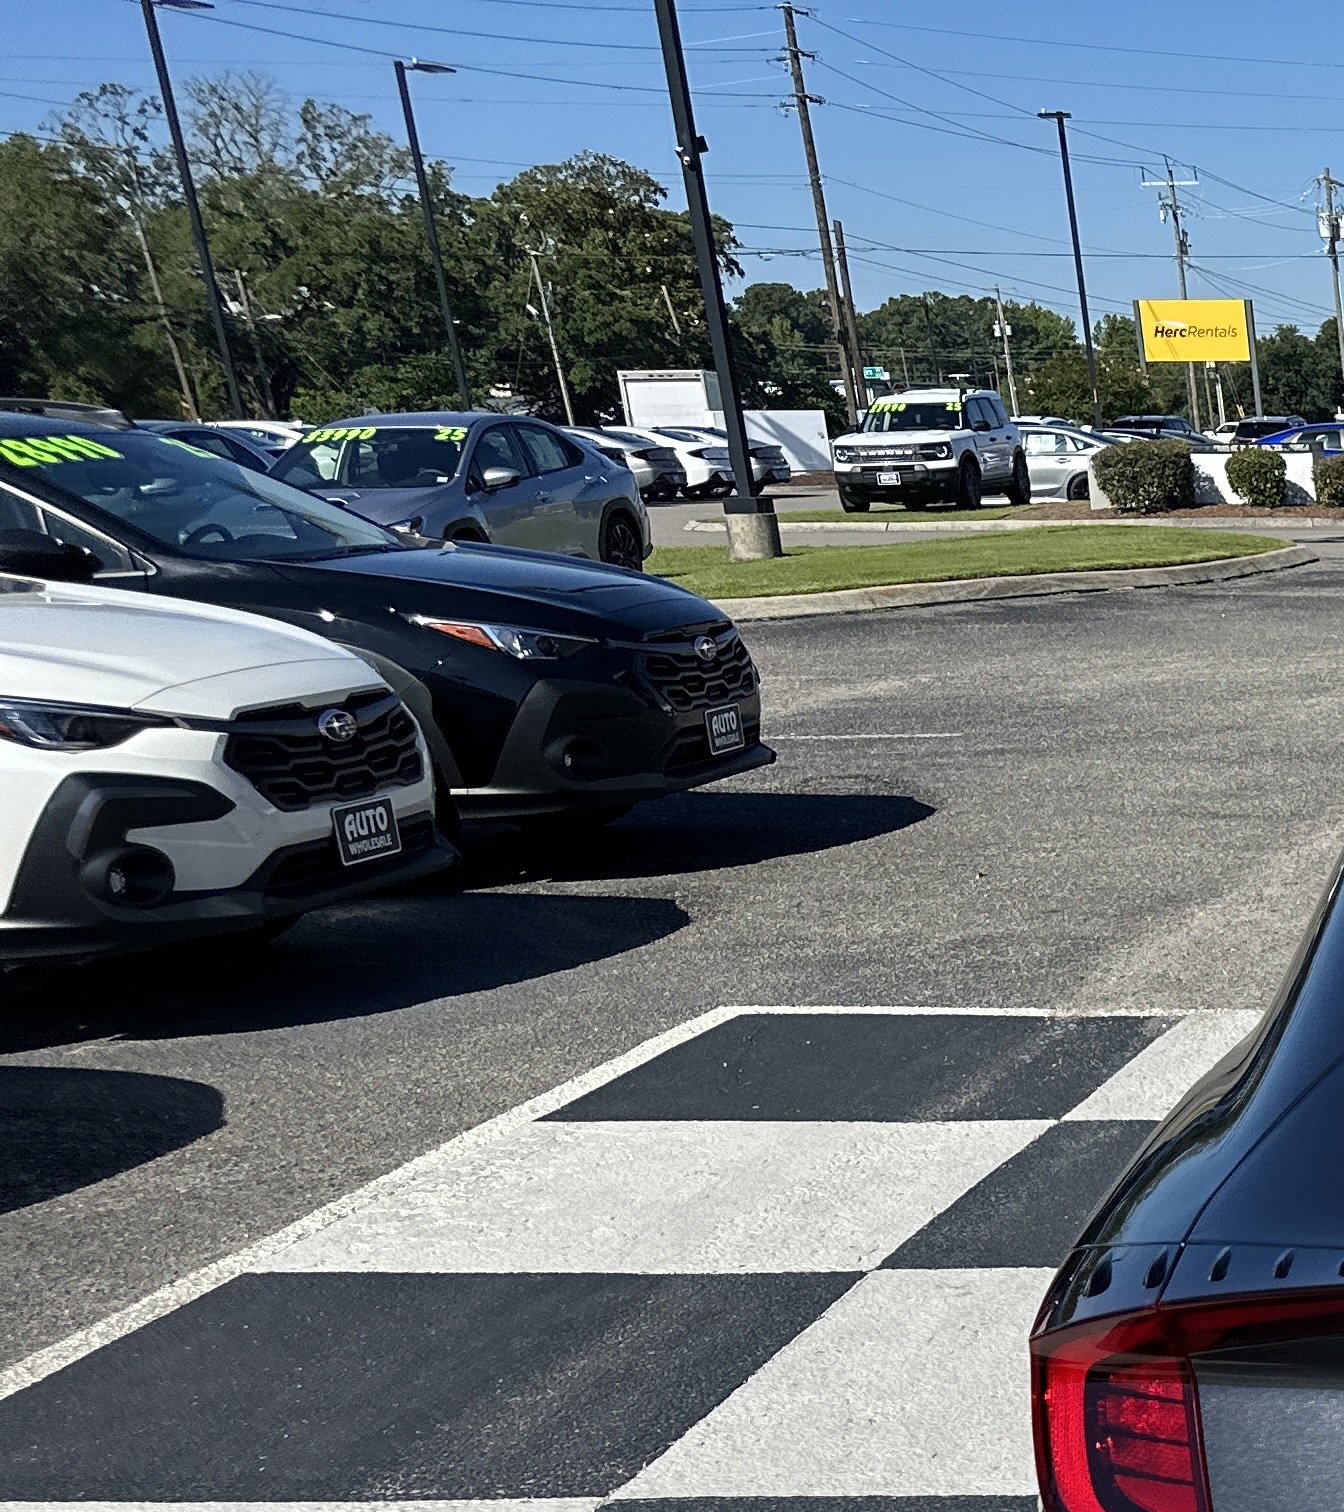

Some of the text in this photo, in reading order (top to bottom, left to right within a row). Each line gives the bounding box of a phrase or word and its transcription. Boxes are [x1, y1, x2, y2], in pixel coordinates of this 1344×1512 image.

[434, 428, 465, 441] 25
[711, 711, 737, 737] AUTO
[344, 806, 388, 841] AUTO
[348, 833, 393, 855] WHOLESALE
